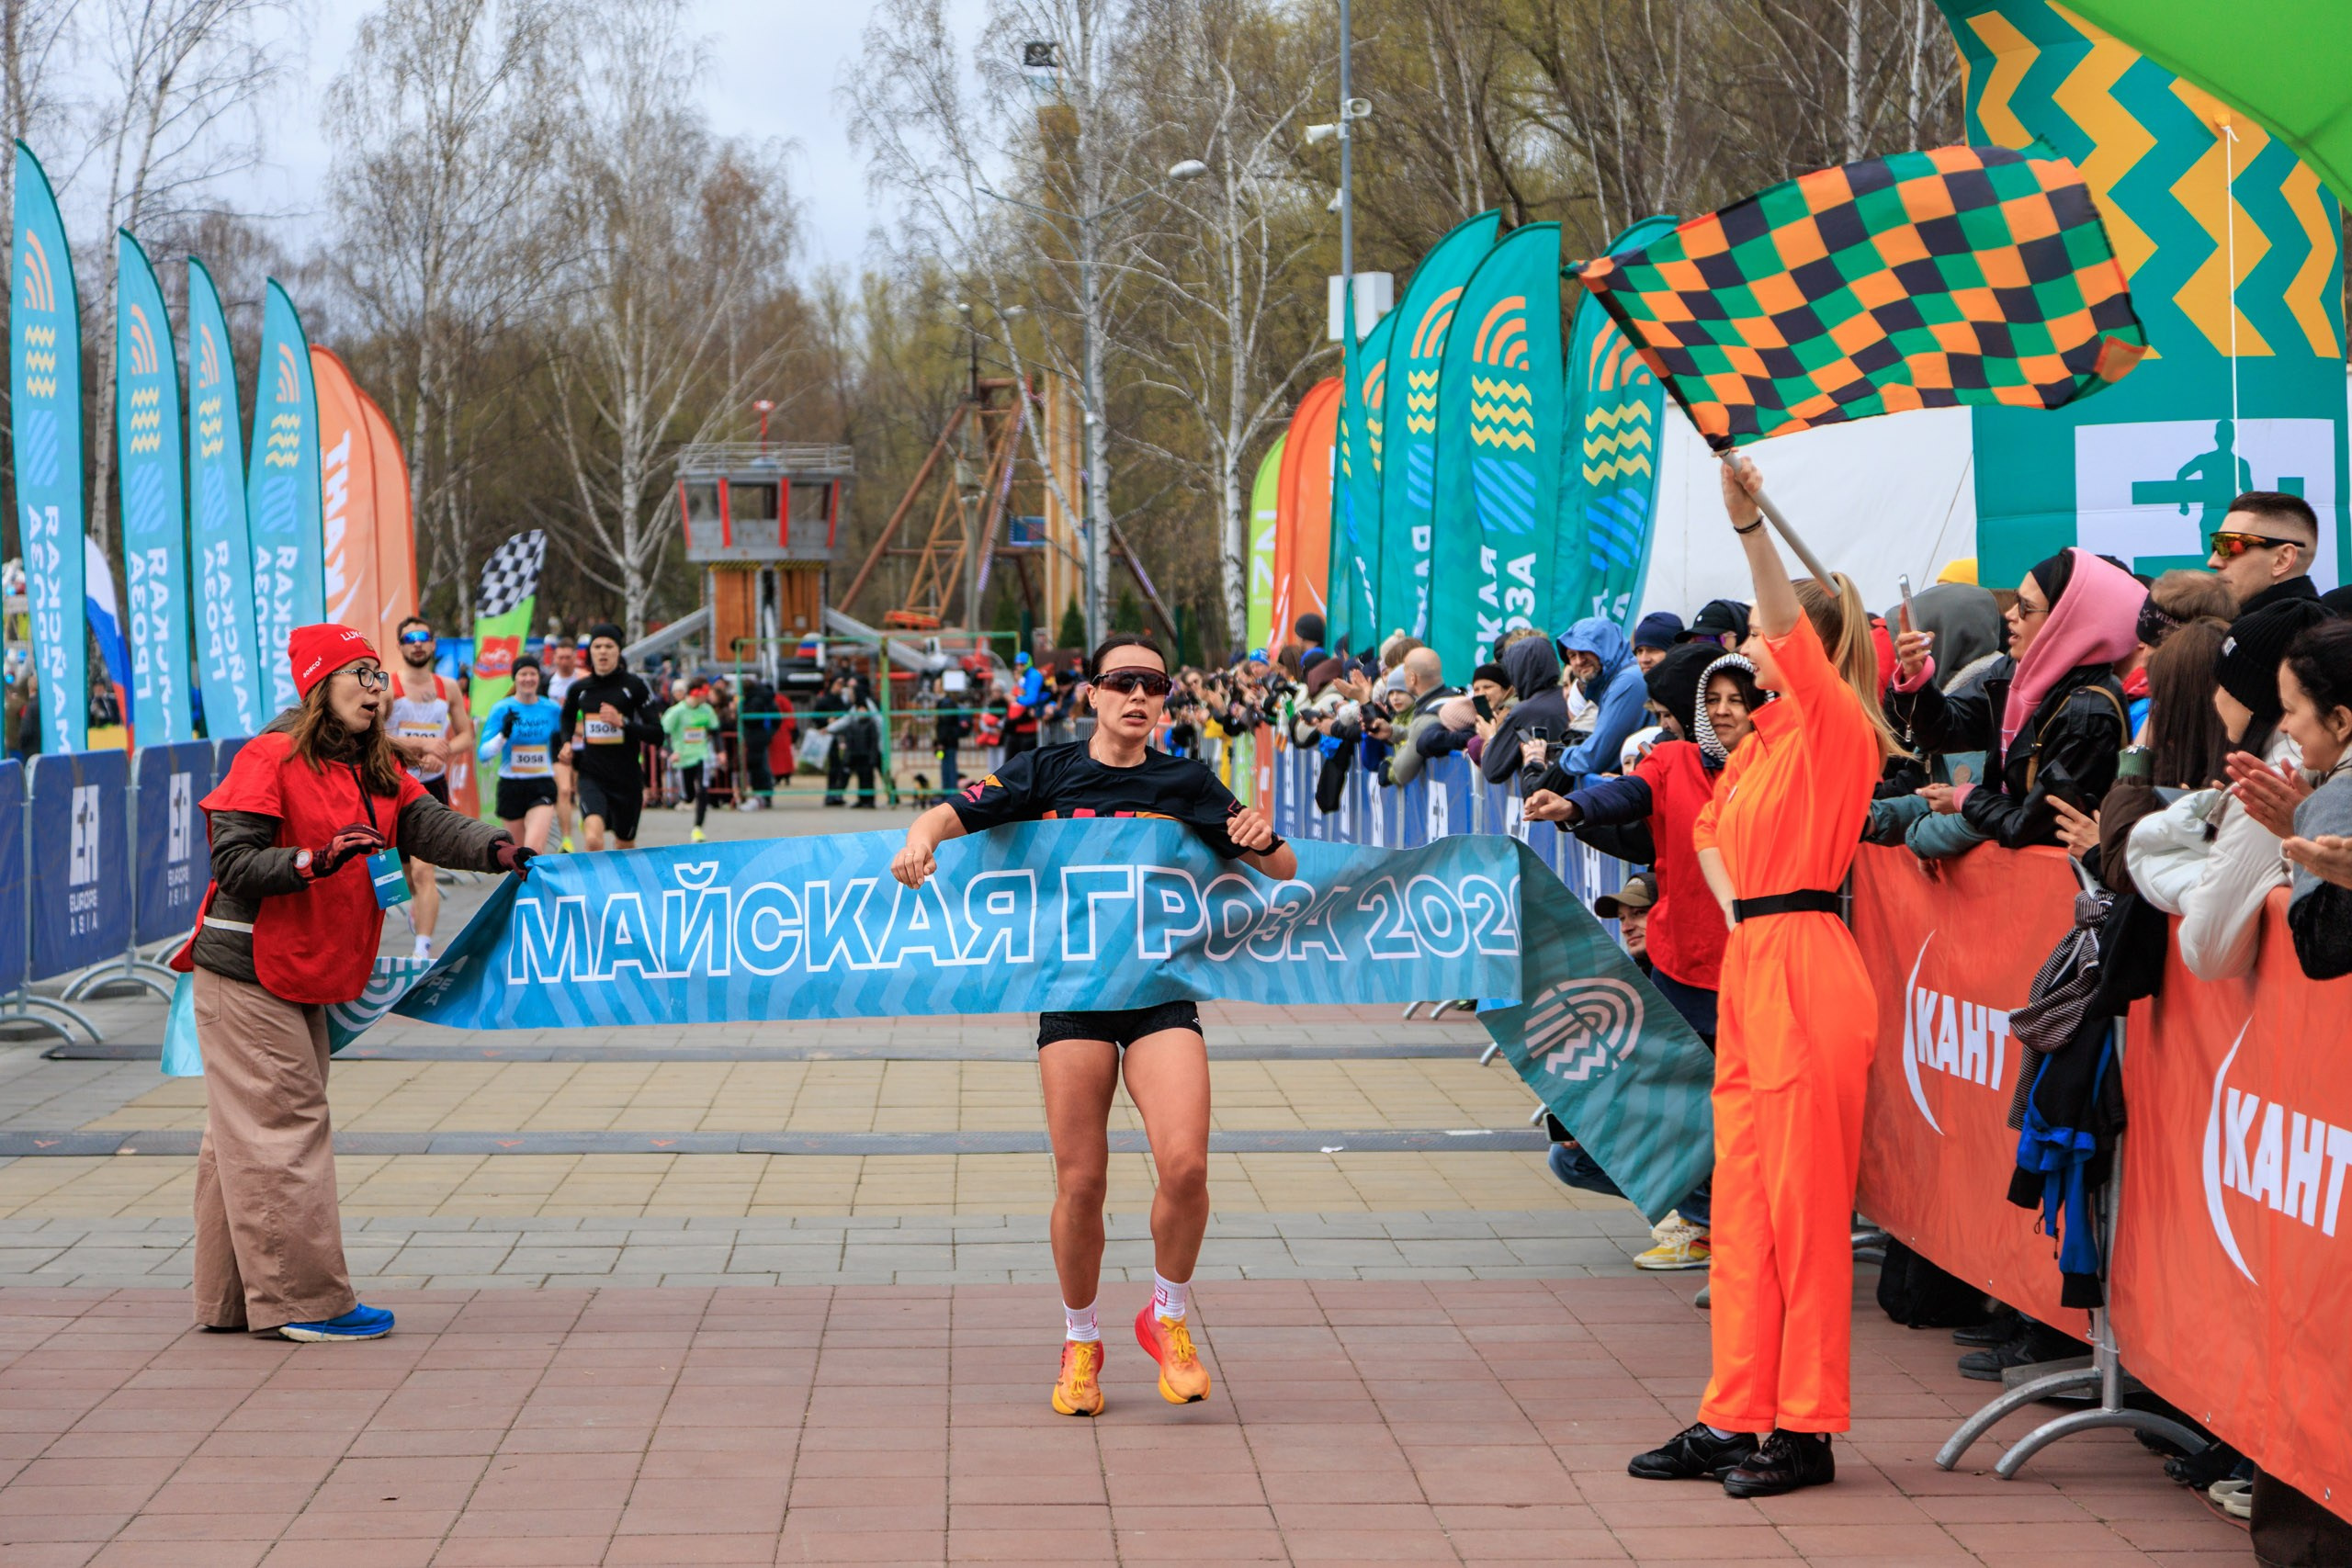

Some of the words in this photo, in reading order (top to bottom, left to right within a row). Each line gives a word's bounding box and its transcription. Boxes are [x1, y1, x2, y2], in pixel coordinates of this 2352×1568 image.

[69, 888, 98, 914] EUROPE
[70, 917, 98, 937] ASIA
[508, 861, 1036, 985] МАЙСКАЯ
[1061, 865, 1351, 963] ГРОЗА
[1917, 987, 2011, 1091] КАНТ
[2223, 1087, 2352, 1238] КАНТ
